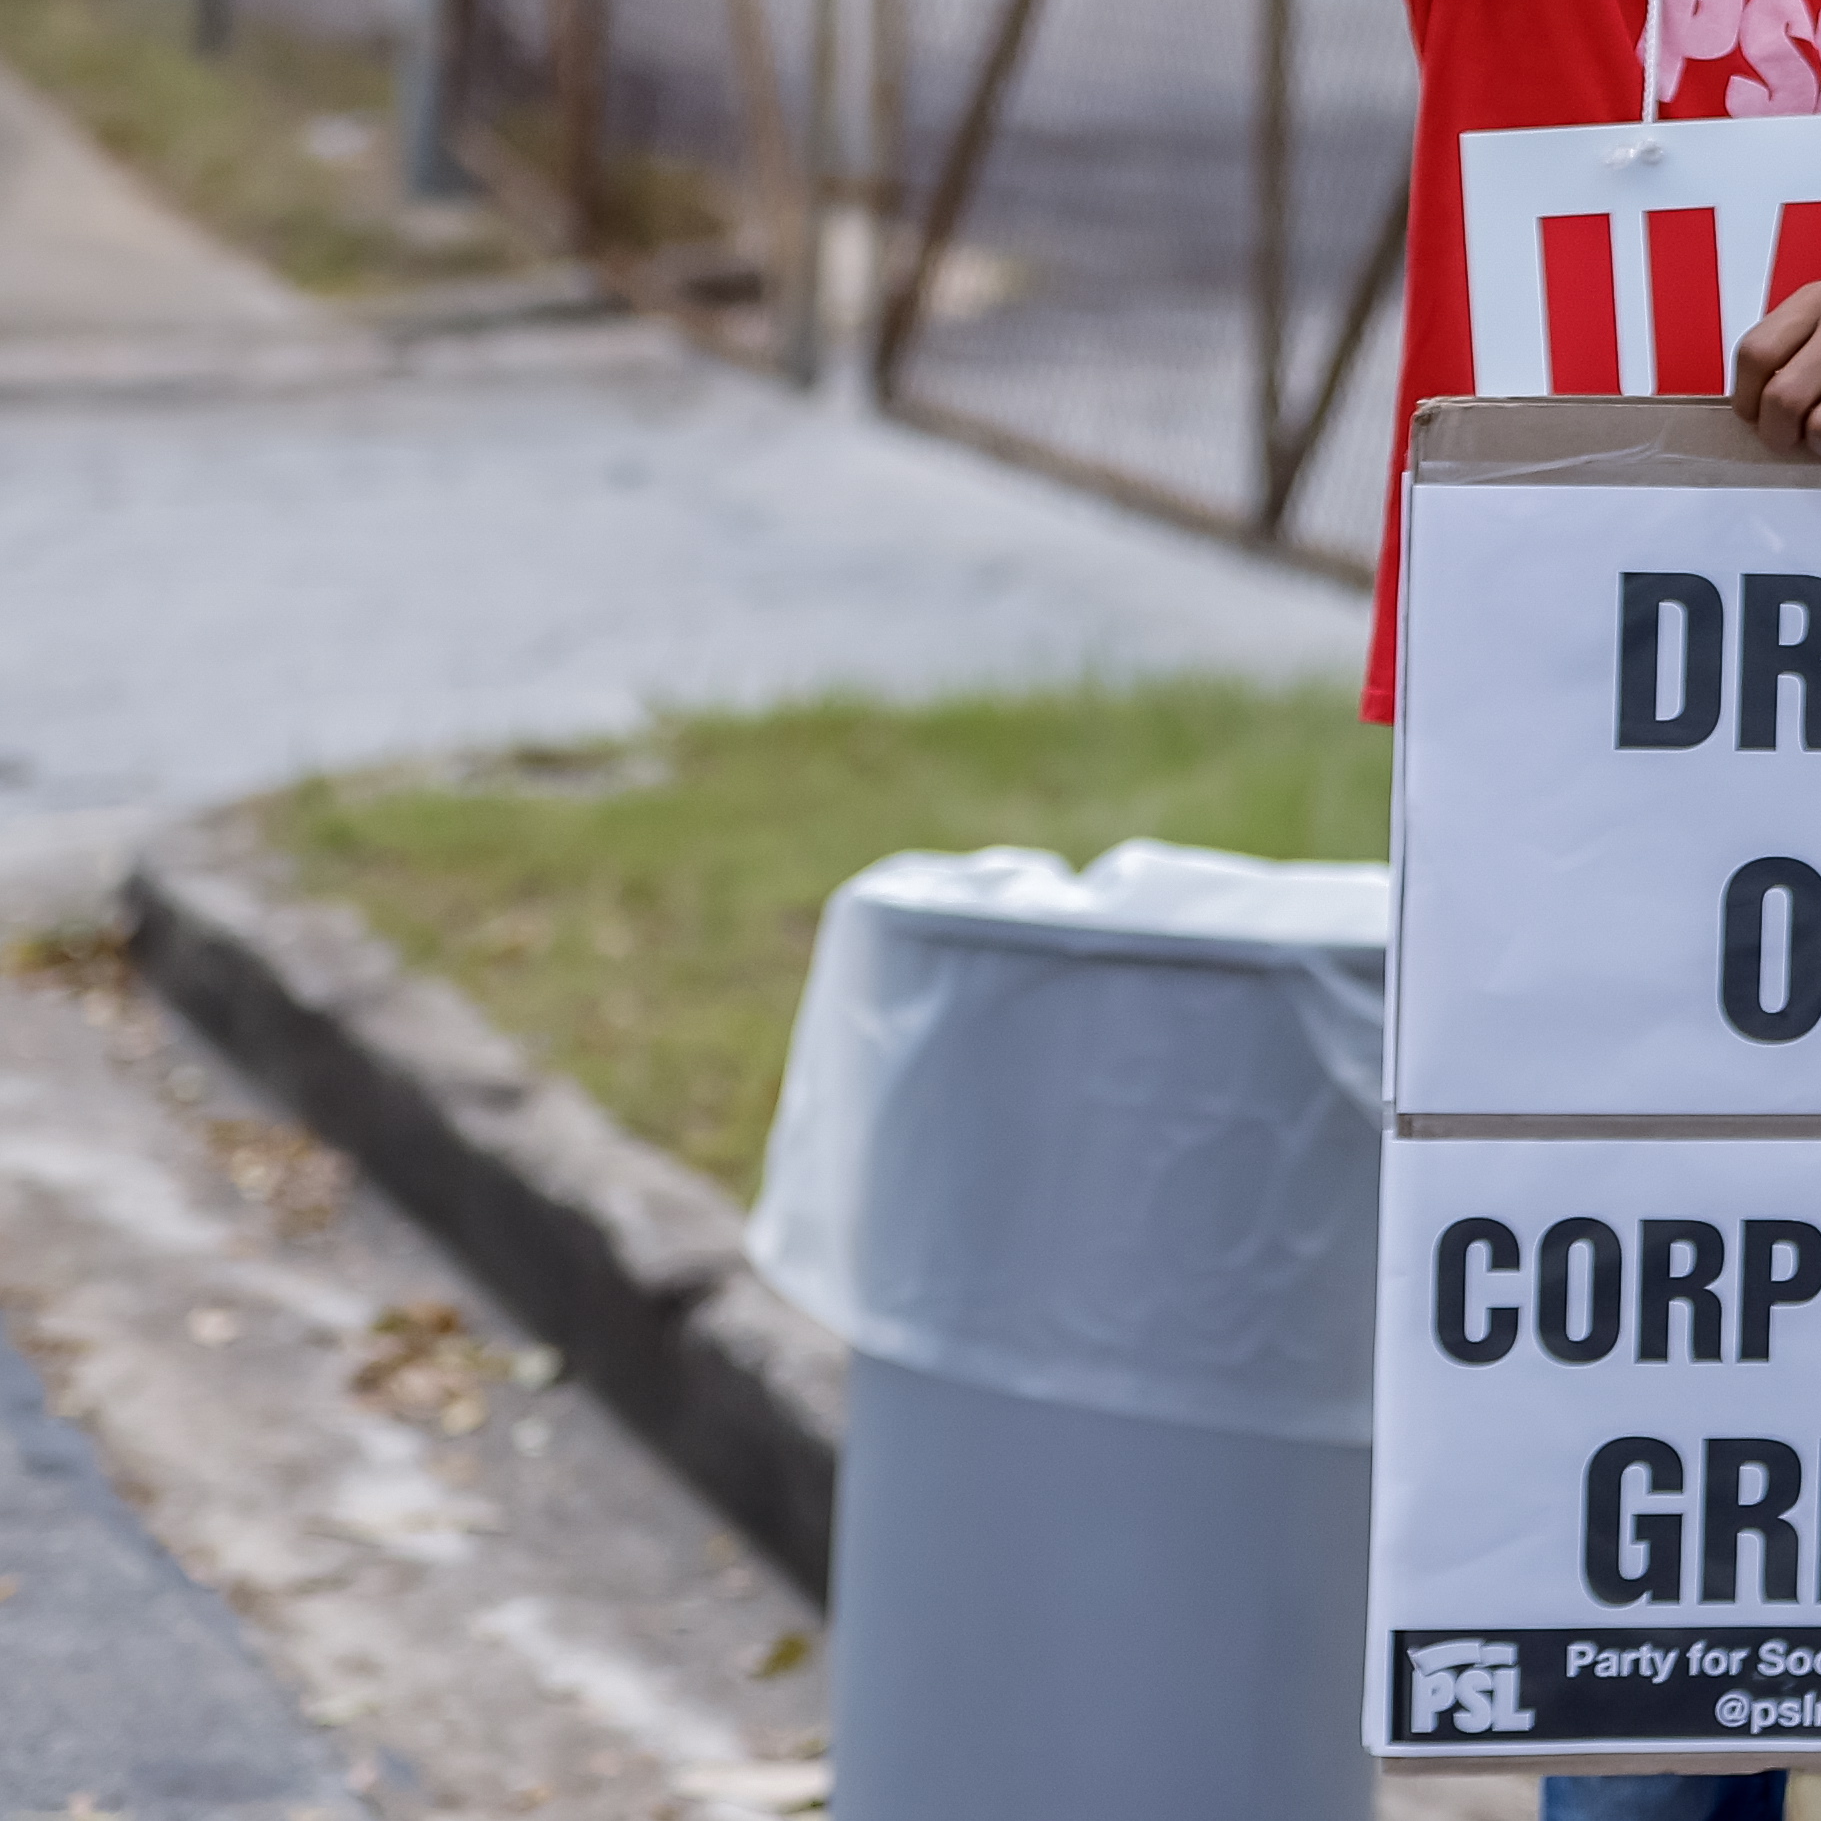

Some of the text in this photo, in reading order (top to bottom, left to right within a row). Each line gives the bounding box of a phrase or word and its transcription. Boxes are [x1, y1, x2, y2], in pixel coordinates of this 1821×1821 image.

[1565, 1638, 1681, 1684] Party
[1687, 1638, 1751, 1678] for
[1409, 1666, 1536, 1734] PSL
